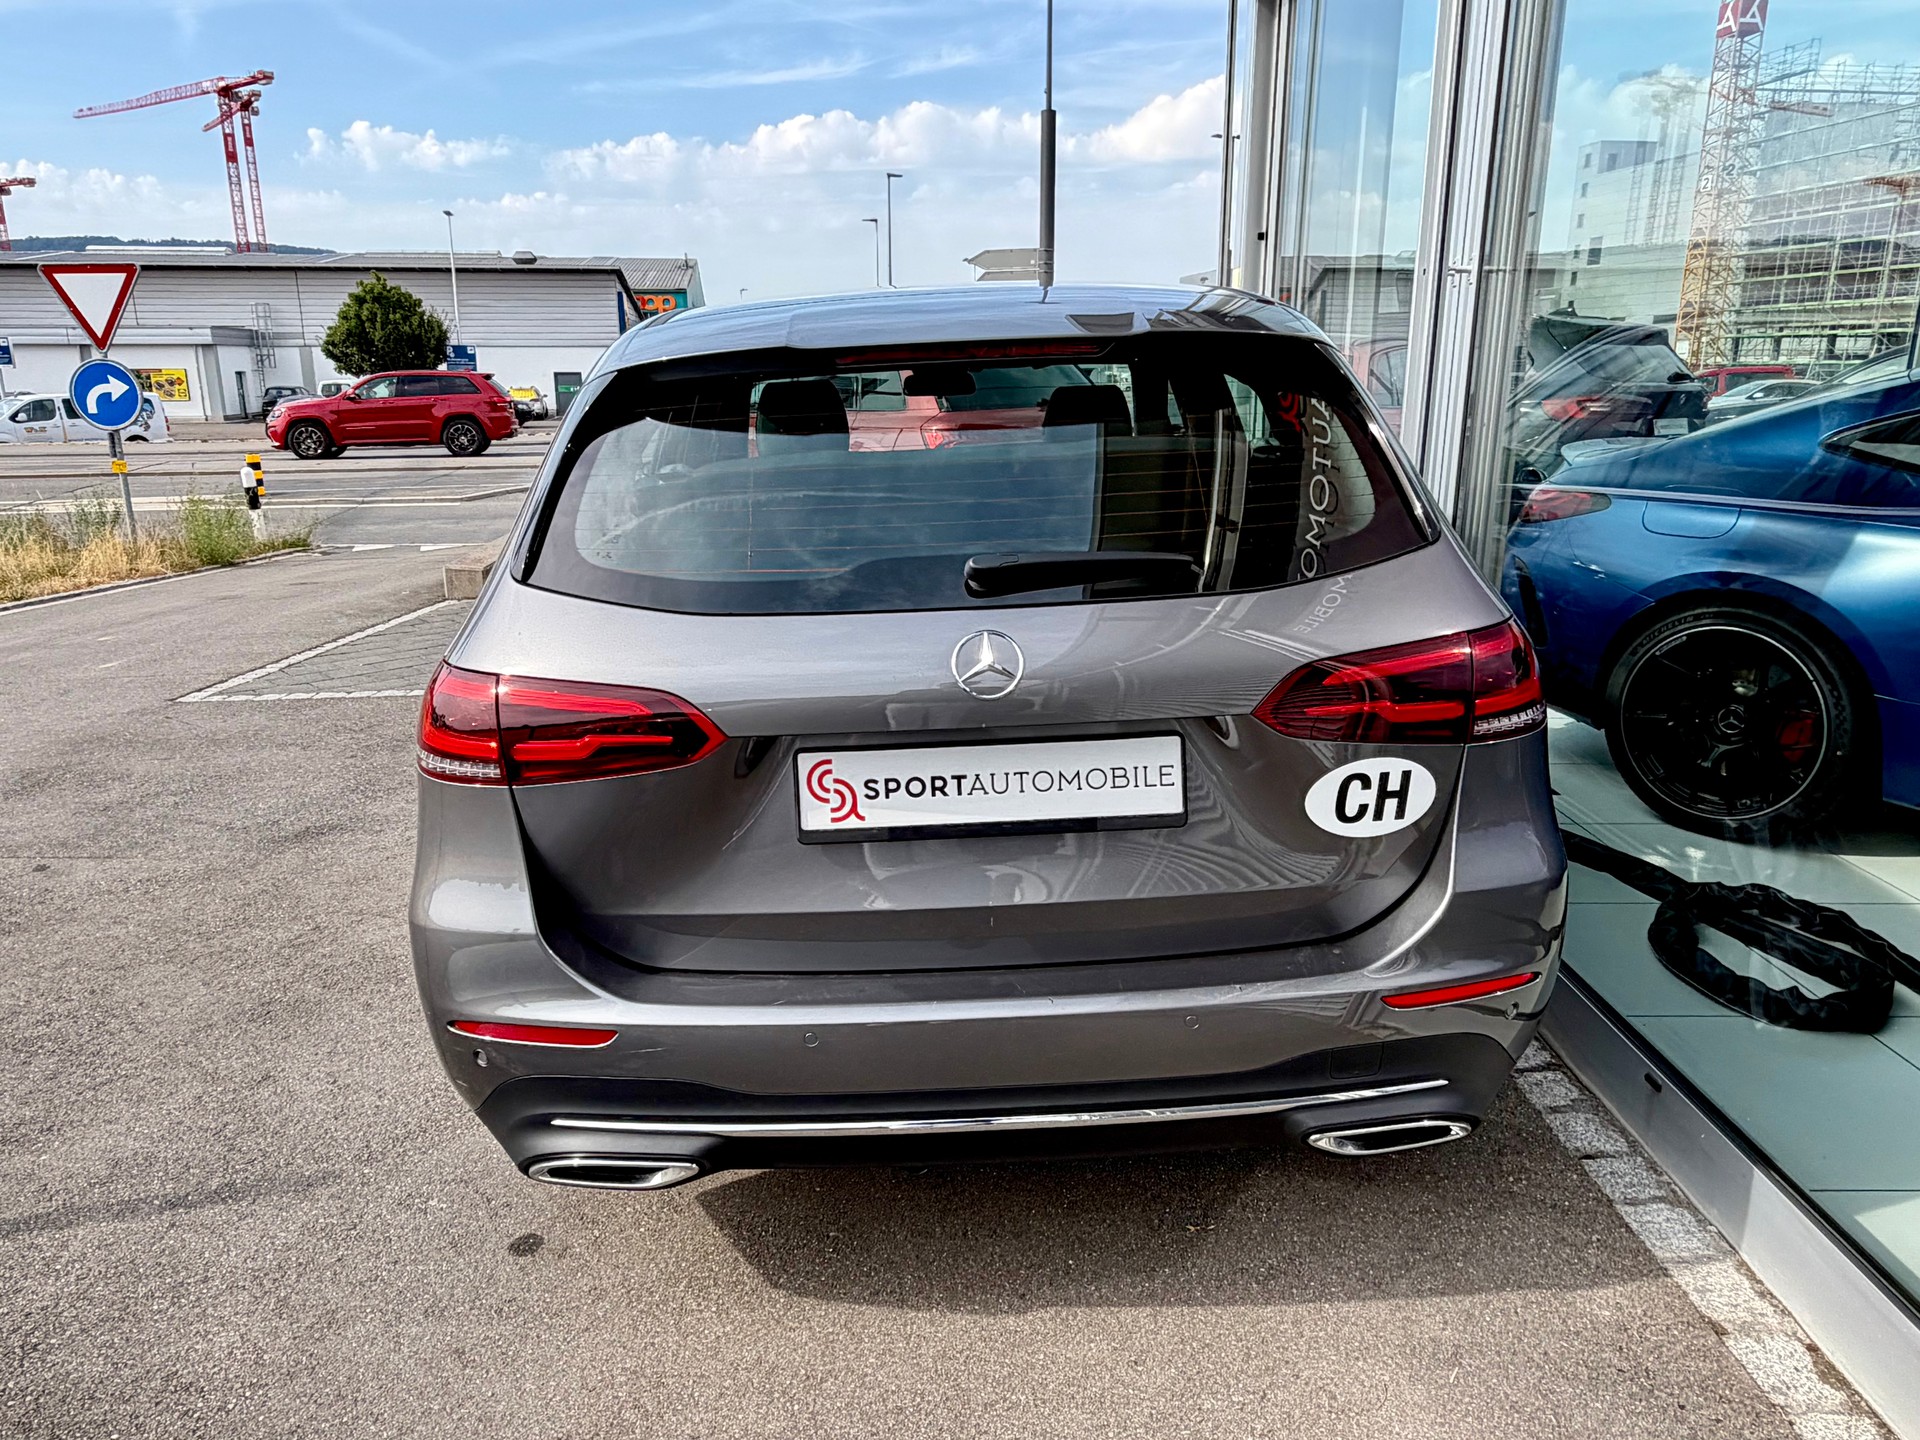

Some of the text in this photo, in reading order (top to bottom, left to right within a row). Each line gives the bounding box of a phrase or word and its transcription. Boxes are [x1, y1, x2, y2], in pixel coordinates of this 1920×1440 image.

[1701, 177, 1710, 191] 2
[863, 764, 1175, 801] SPORTAUTOMOBILE
[1335, 770, 1412, 824] CH
